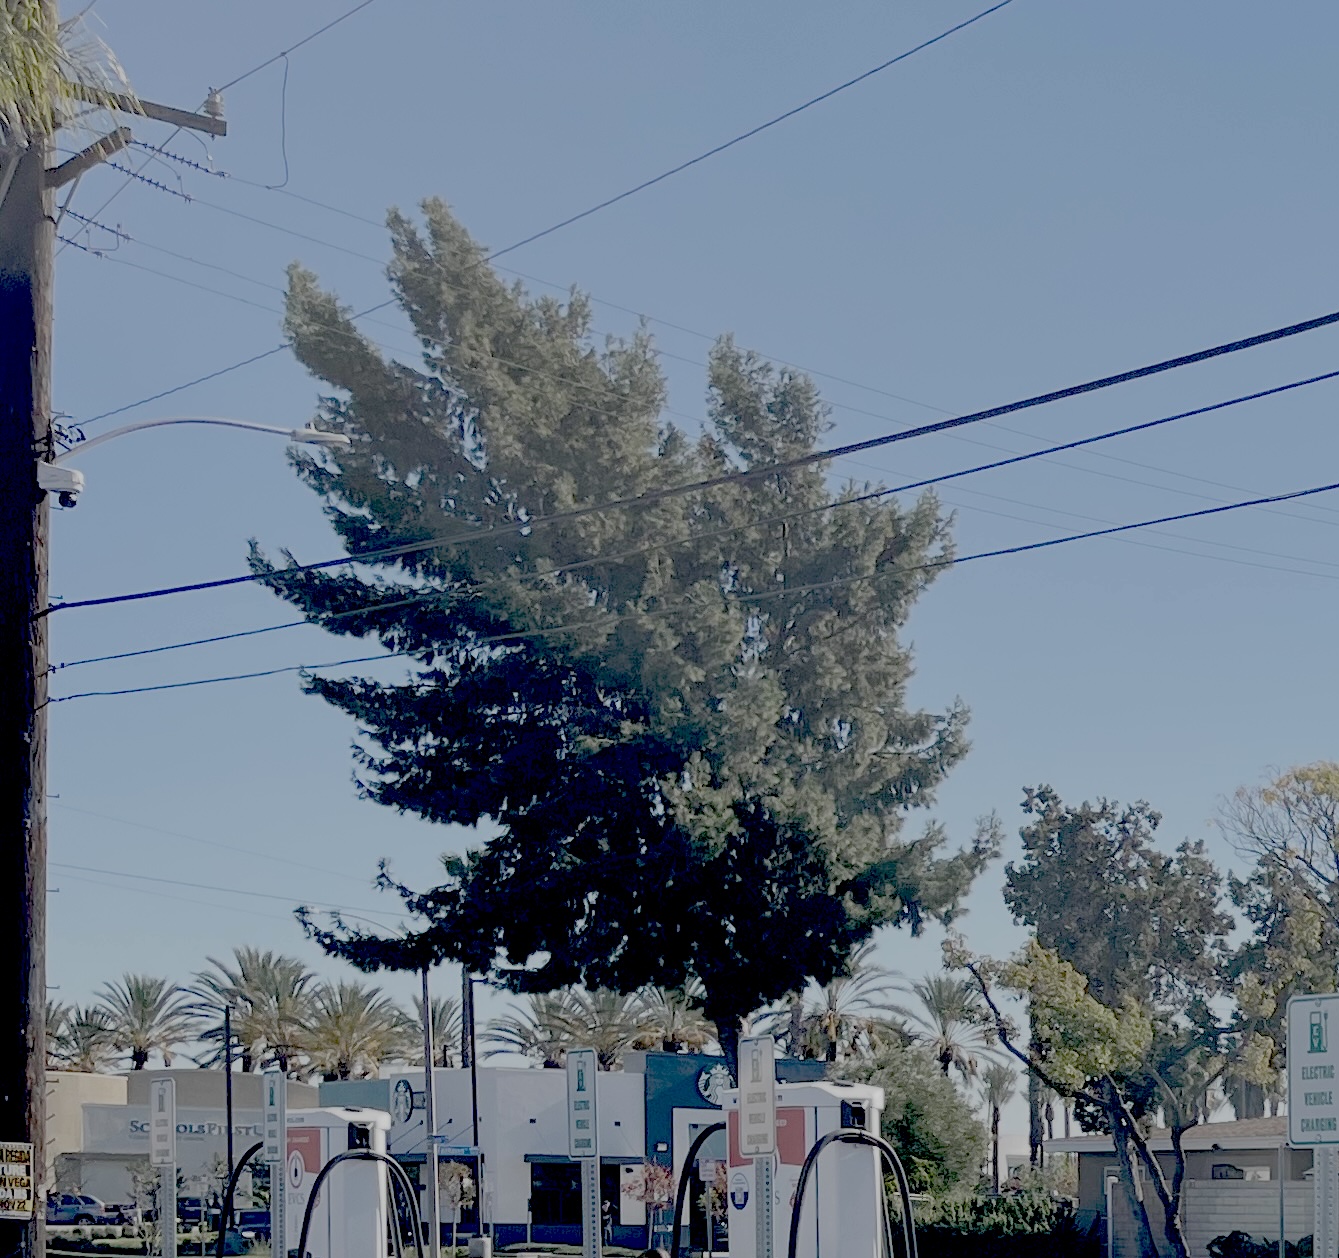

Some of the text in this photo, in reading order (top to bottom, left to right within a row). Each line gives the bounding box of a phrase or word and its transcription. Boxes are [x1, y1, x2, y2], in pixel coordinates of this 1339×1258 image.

[1301, 1065, 1334, 1080] ELECTRIC
[1304, 1091, 1333, 1106] VEHICLE
[1300, 1117, 1337, 1132] CHARGING
